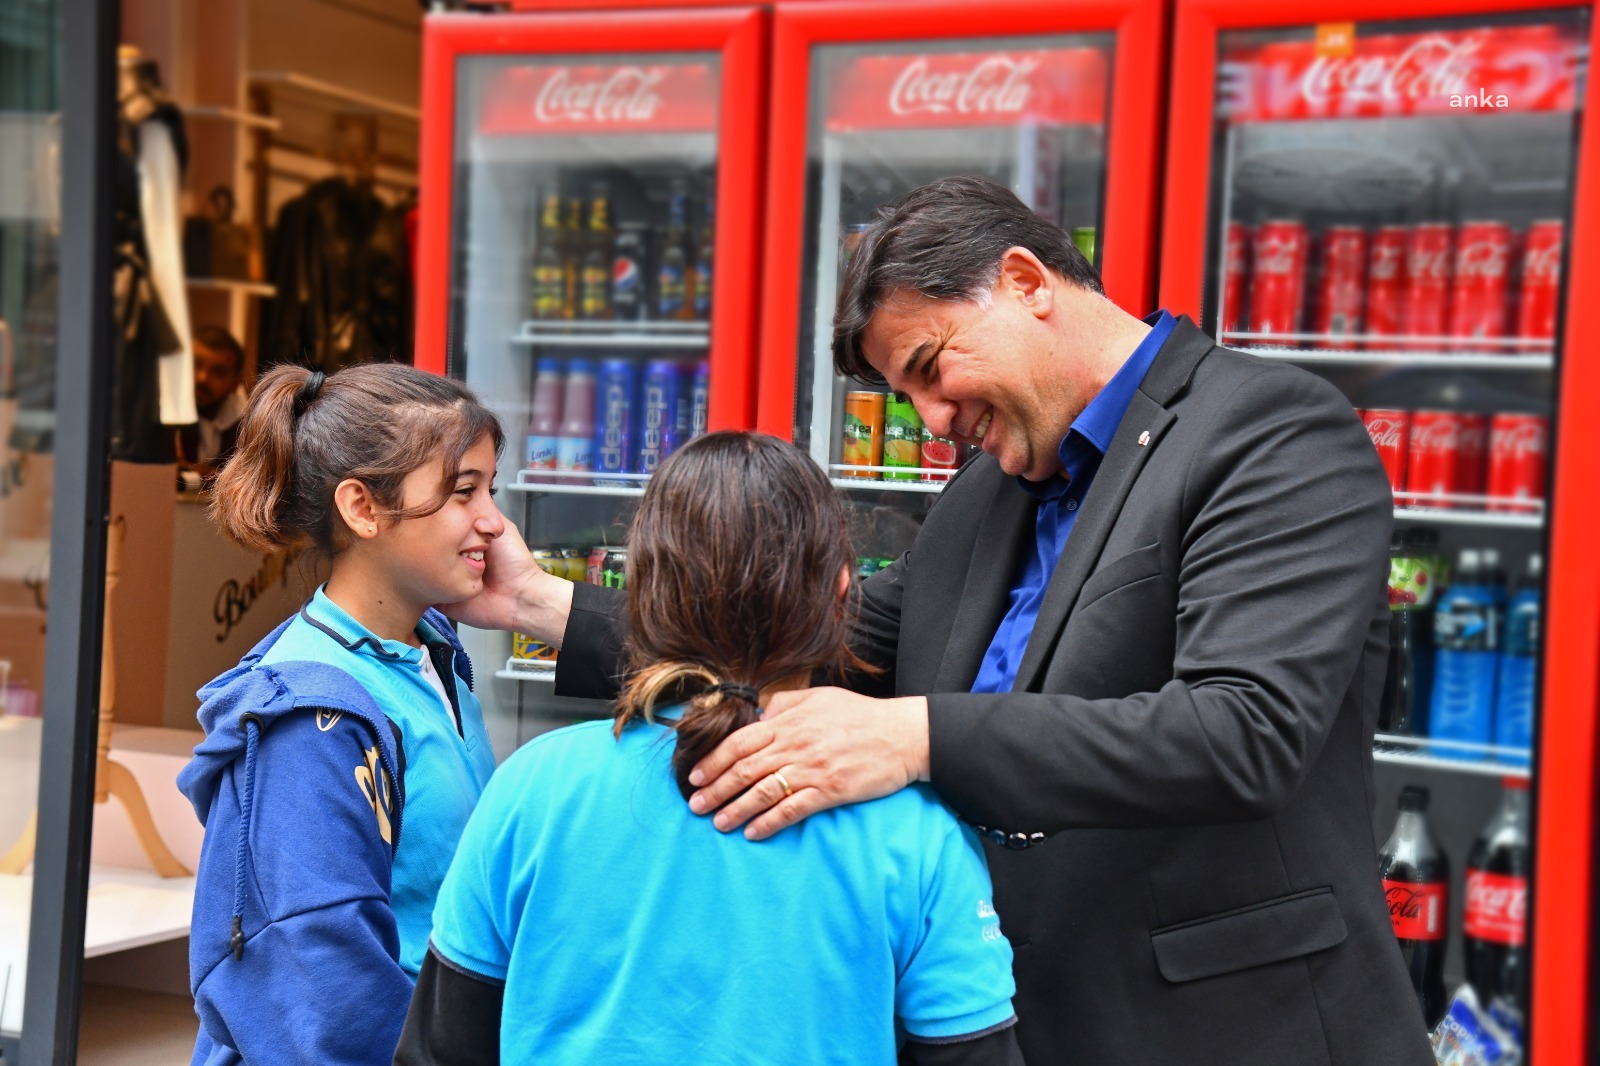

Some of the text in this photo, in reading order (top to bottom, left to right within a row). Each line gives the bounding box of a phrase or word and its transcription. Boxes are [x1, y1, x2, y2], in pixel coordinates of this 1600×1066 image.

[531, 448, 553, 461] Link
[600, 385, 629, 469] deep
[641, 386, 667, 471] deep
